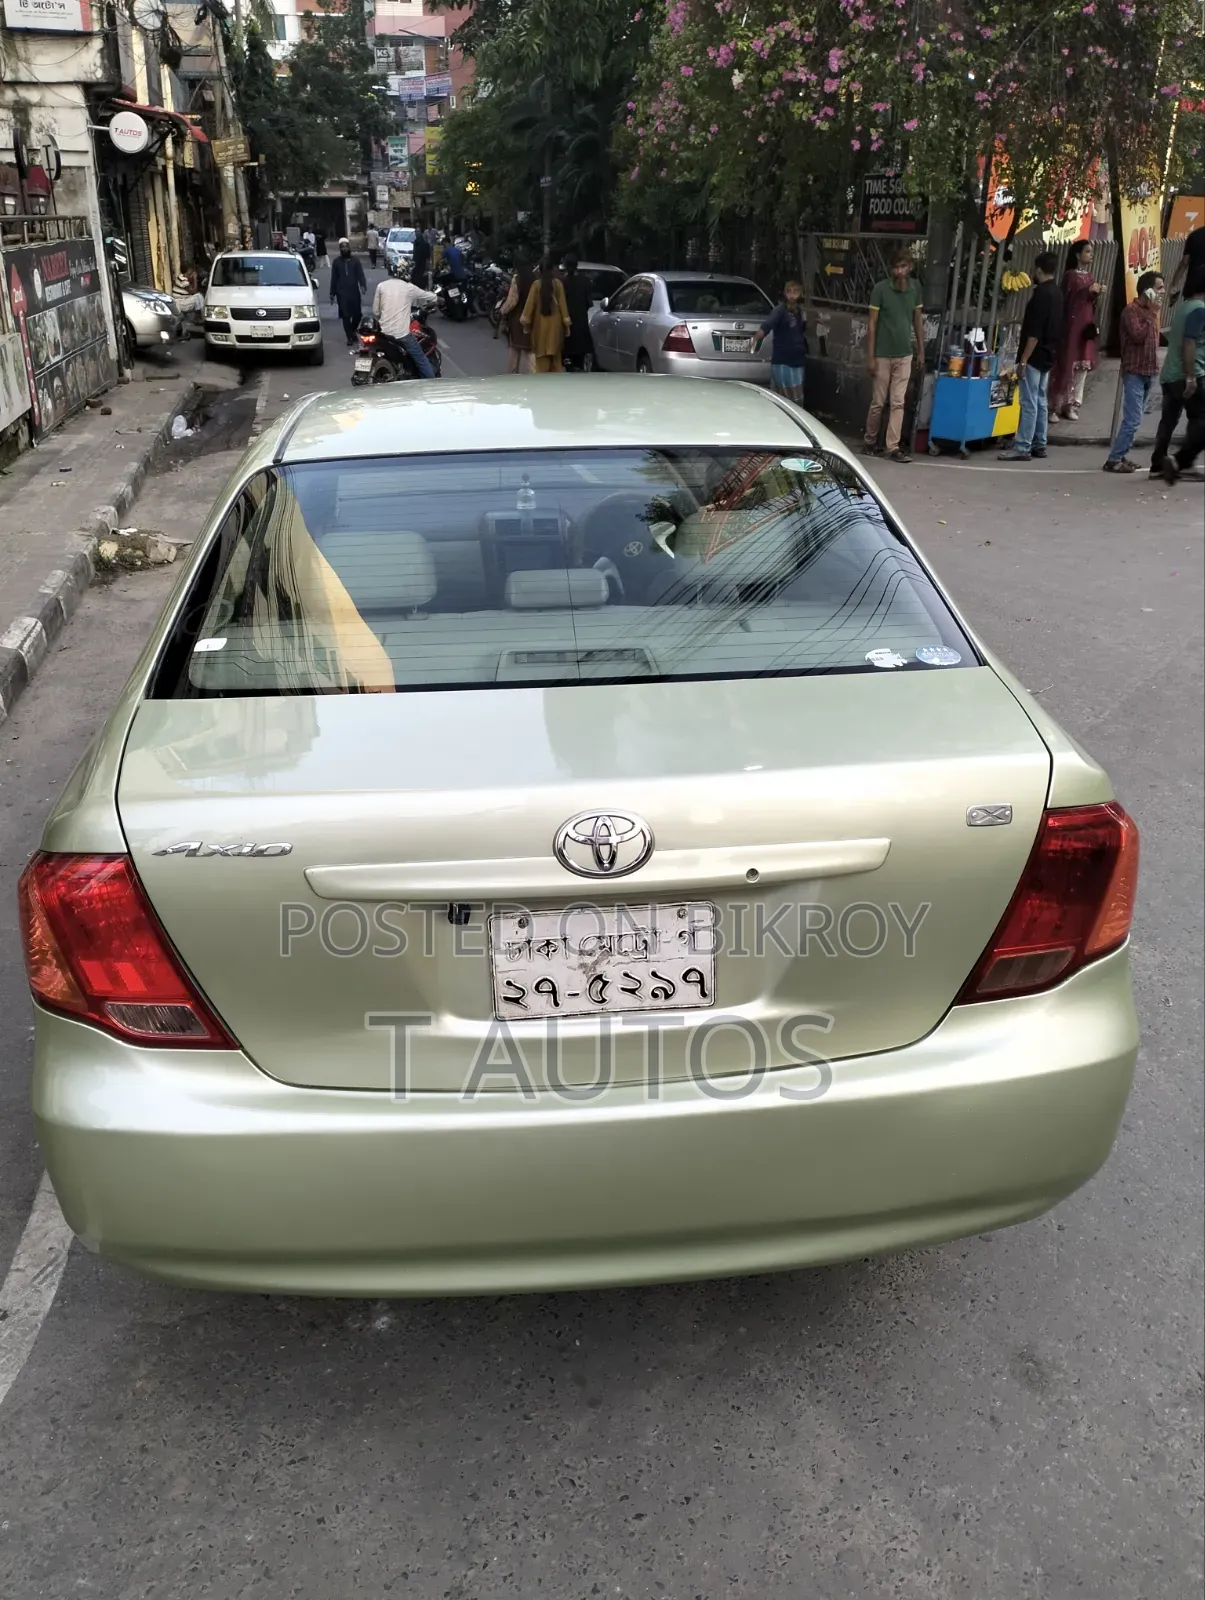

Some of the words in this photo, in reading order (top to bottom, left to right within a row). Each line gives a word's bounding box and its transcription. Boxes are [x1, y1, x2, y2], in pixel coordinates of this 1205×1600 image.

[119, 128, 142, 136] AUTOS
[865, 179, 887, 194] TIME
[868, 198, 892, 215] FOOD
[13, 285, 24, 303] 2nd
[504, 934, 571, 962] ঢাকা
